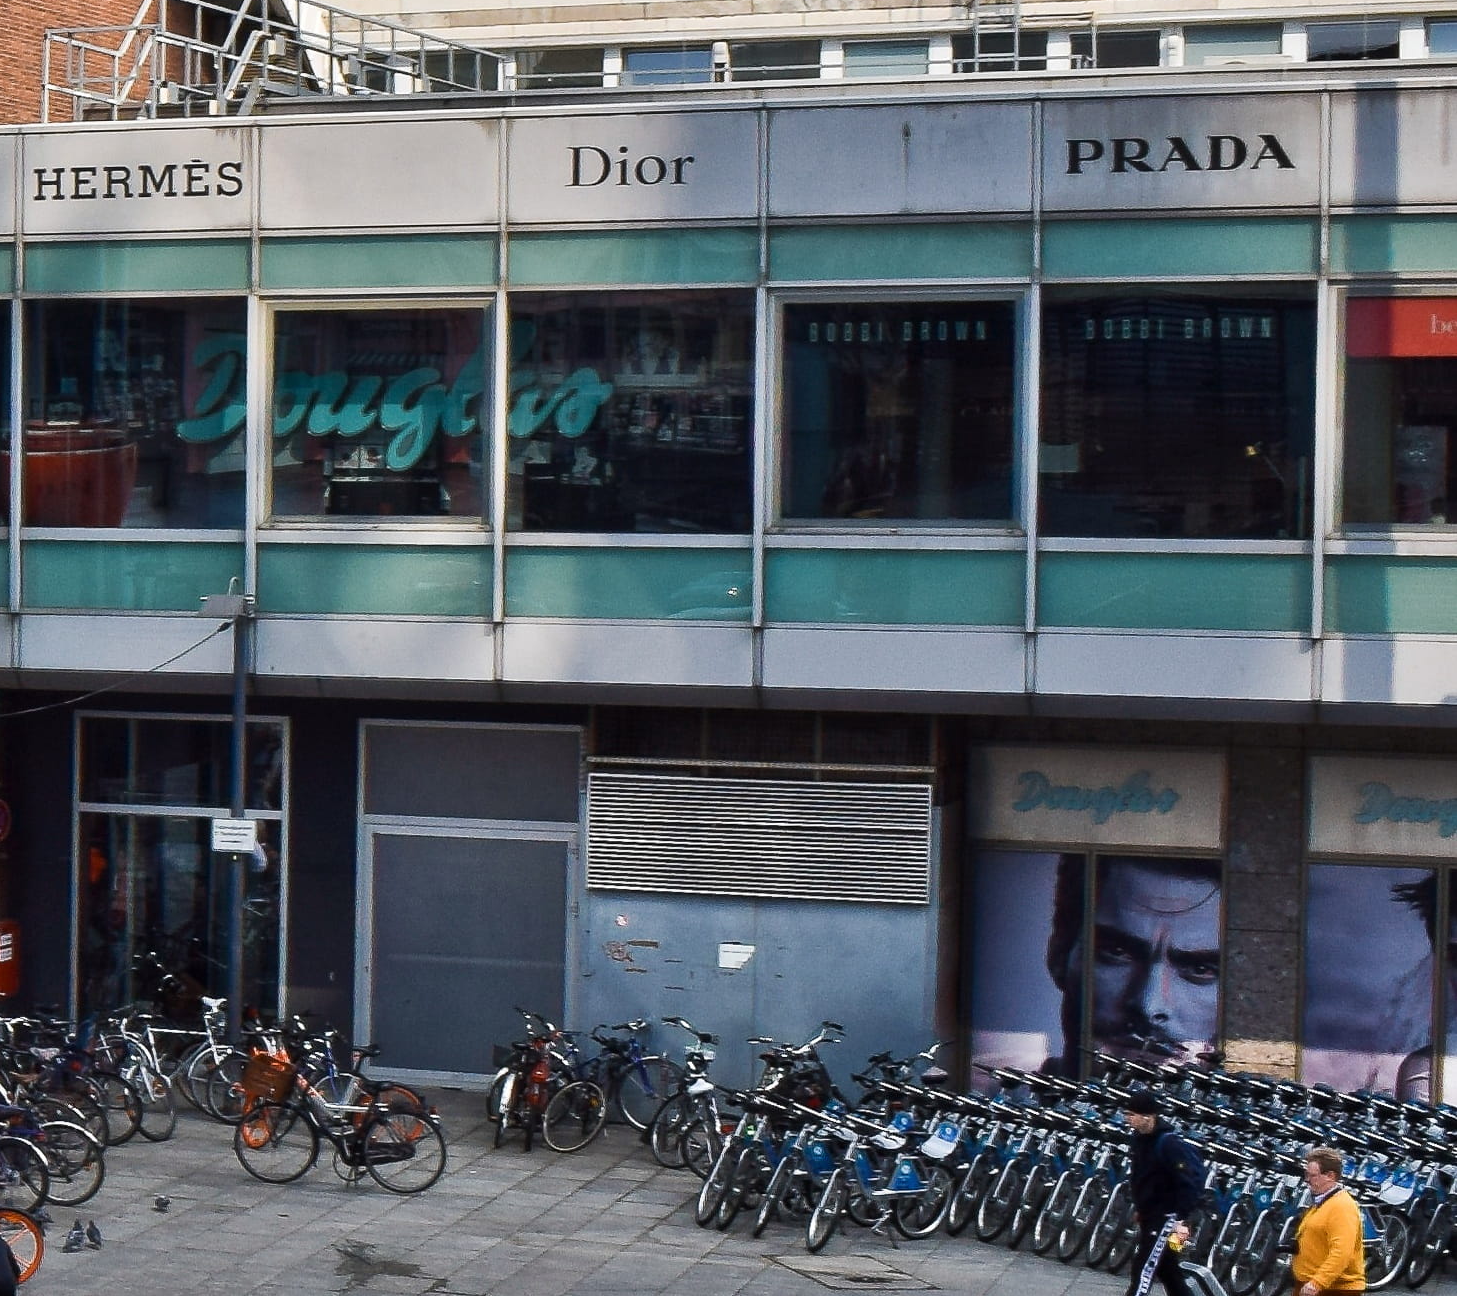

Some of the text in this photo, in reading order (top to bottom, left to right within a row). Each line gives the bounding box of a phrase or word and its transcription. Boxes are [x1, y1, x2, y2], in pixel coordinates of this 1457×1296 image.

[564, 145, 696, 188] Dior
[1065, 133, 1296, 176] PRADA
[32, 158, 244, 202] HERMÈS
[808, 318, 988, 343] BOBBI BROWN
[1084, 315, 1274, 341] BOBBI BROWN
[175, 318, 613, 472] Douglas
[1011, 770, 1181, 826] Douglas
